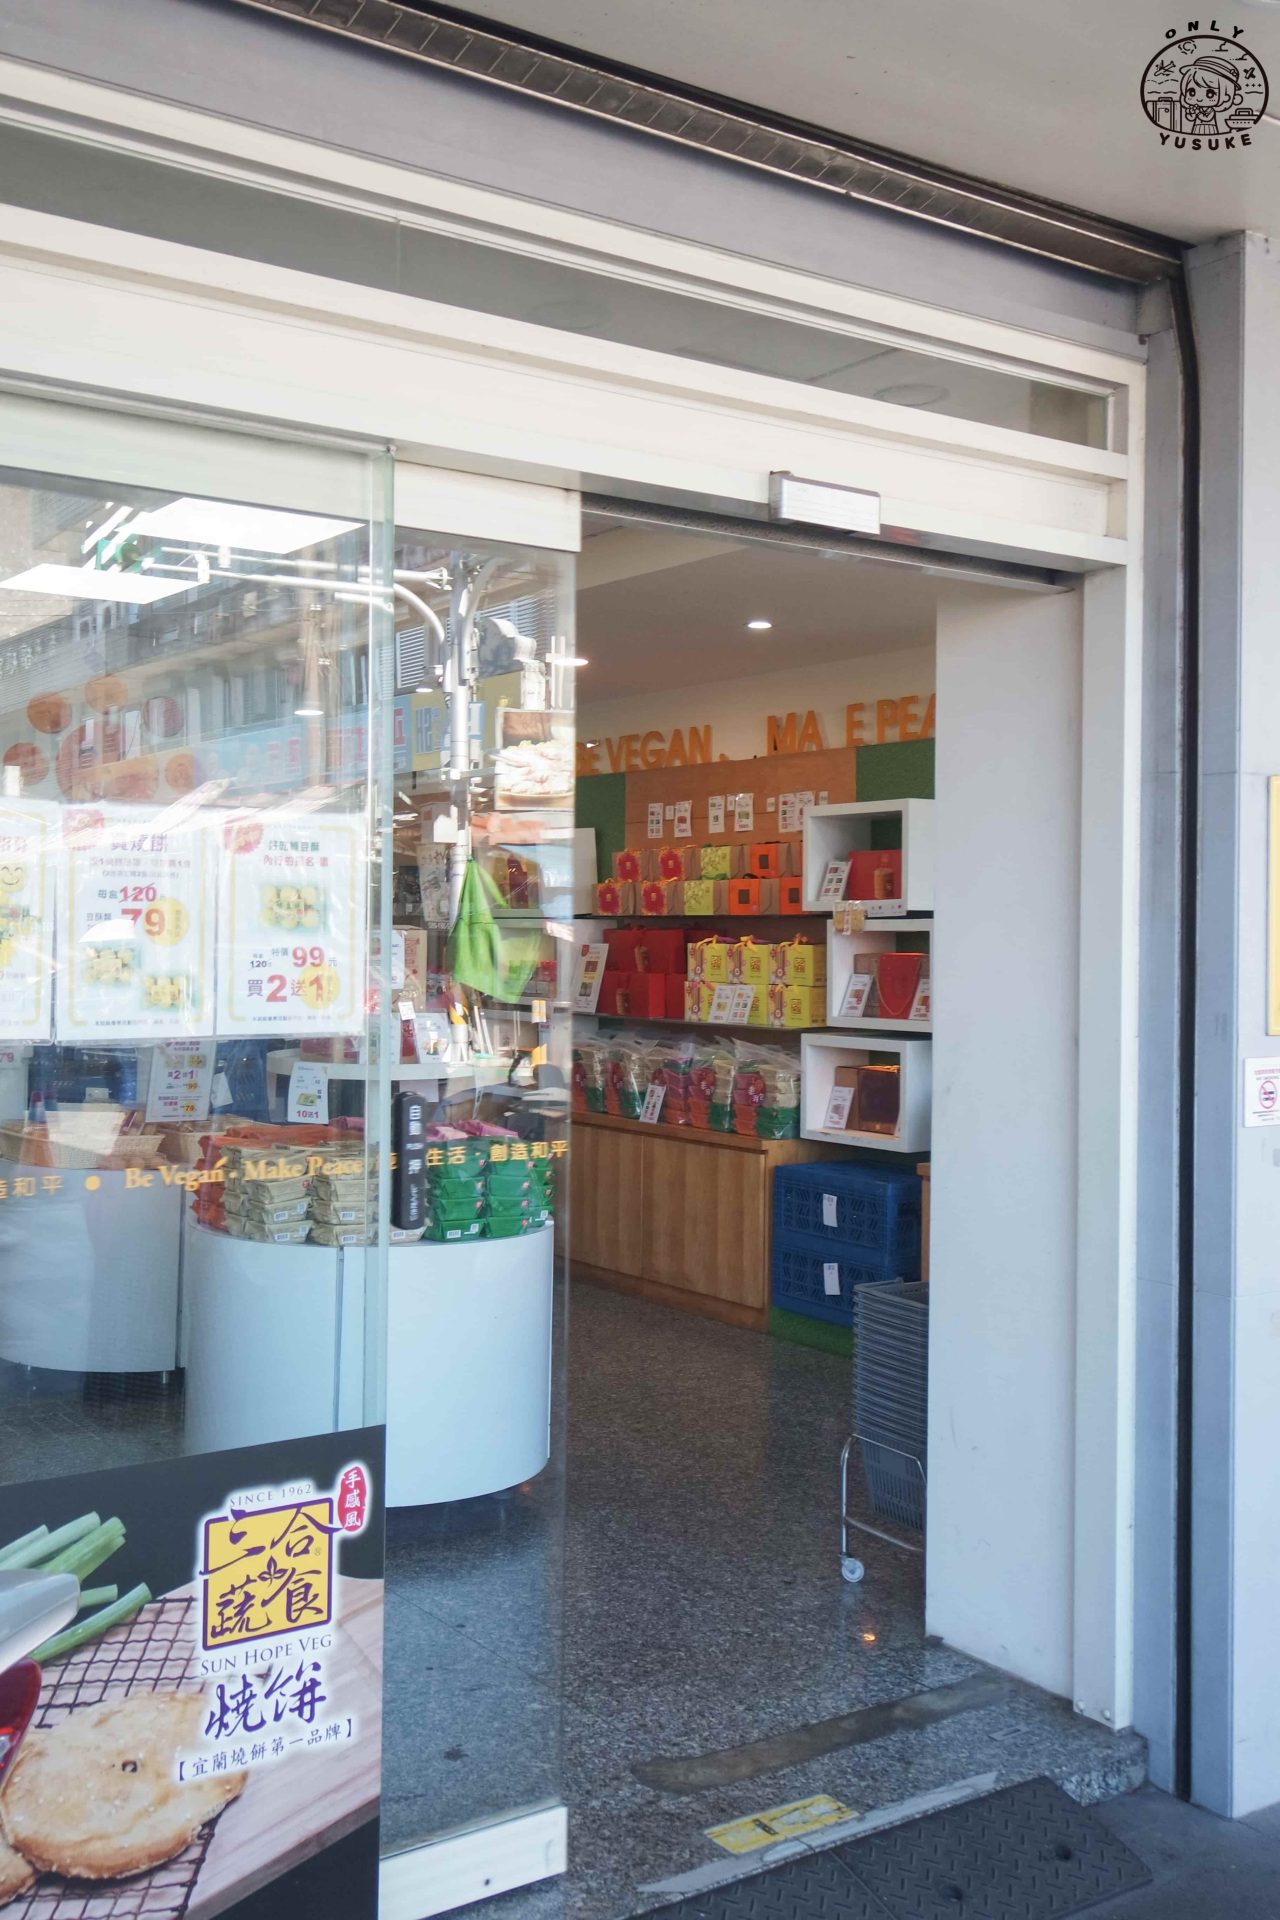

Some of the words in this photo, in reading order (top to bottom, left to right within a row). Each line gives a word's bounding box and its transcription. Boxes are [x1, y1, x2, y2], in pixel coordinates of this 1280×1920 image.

[120, 907, 166, 937] 79
[291, 946, 325, 968] 99
[125, 1167, 154, 1189] Be
[244, 1160, 302, 1181] Make
[307, 1155, 365, 1176] Peace
[229, 1491, 274, 1507] SINCE
[281, 1483, 313, 1499] 1962
[343, 1469, 362, 1529] 手感風
[210, 1567, 324, 1639] 蔬食
[200, 1655, 237, 1677] SUN
[244, 1642, 293, 1669] HOPE
[298, 1634, 332, 1657] VEG
[204, 1660, 327, 1740] 燒餅
